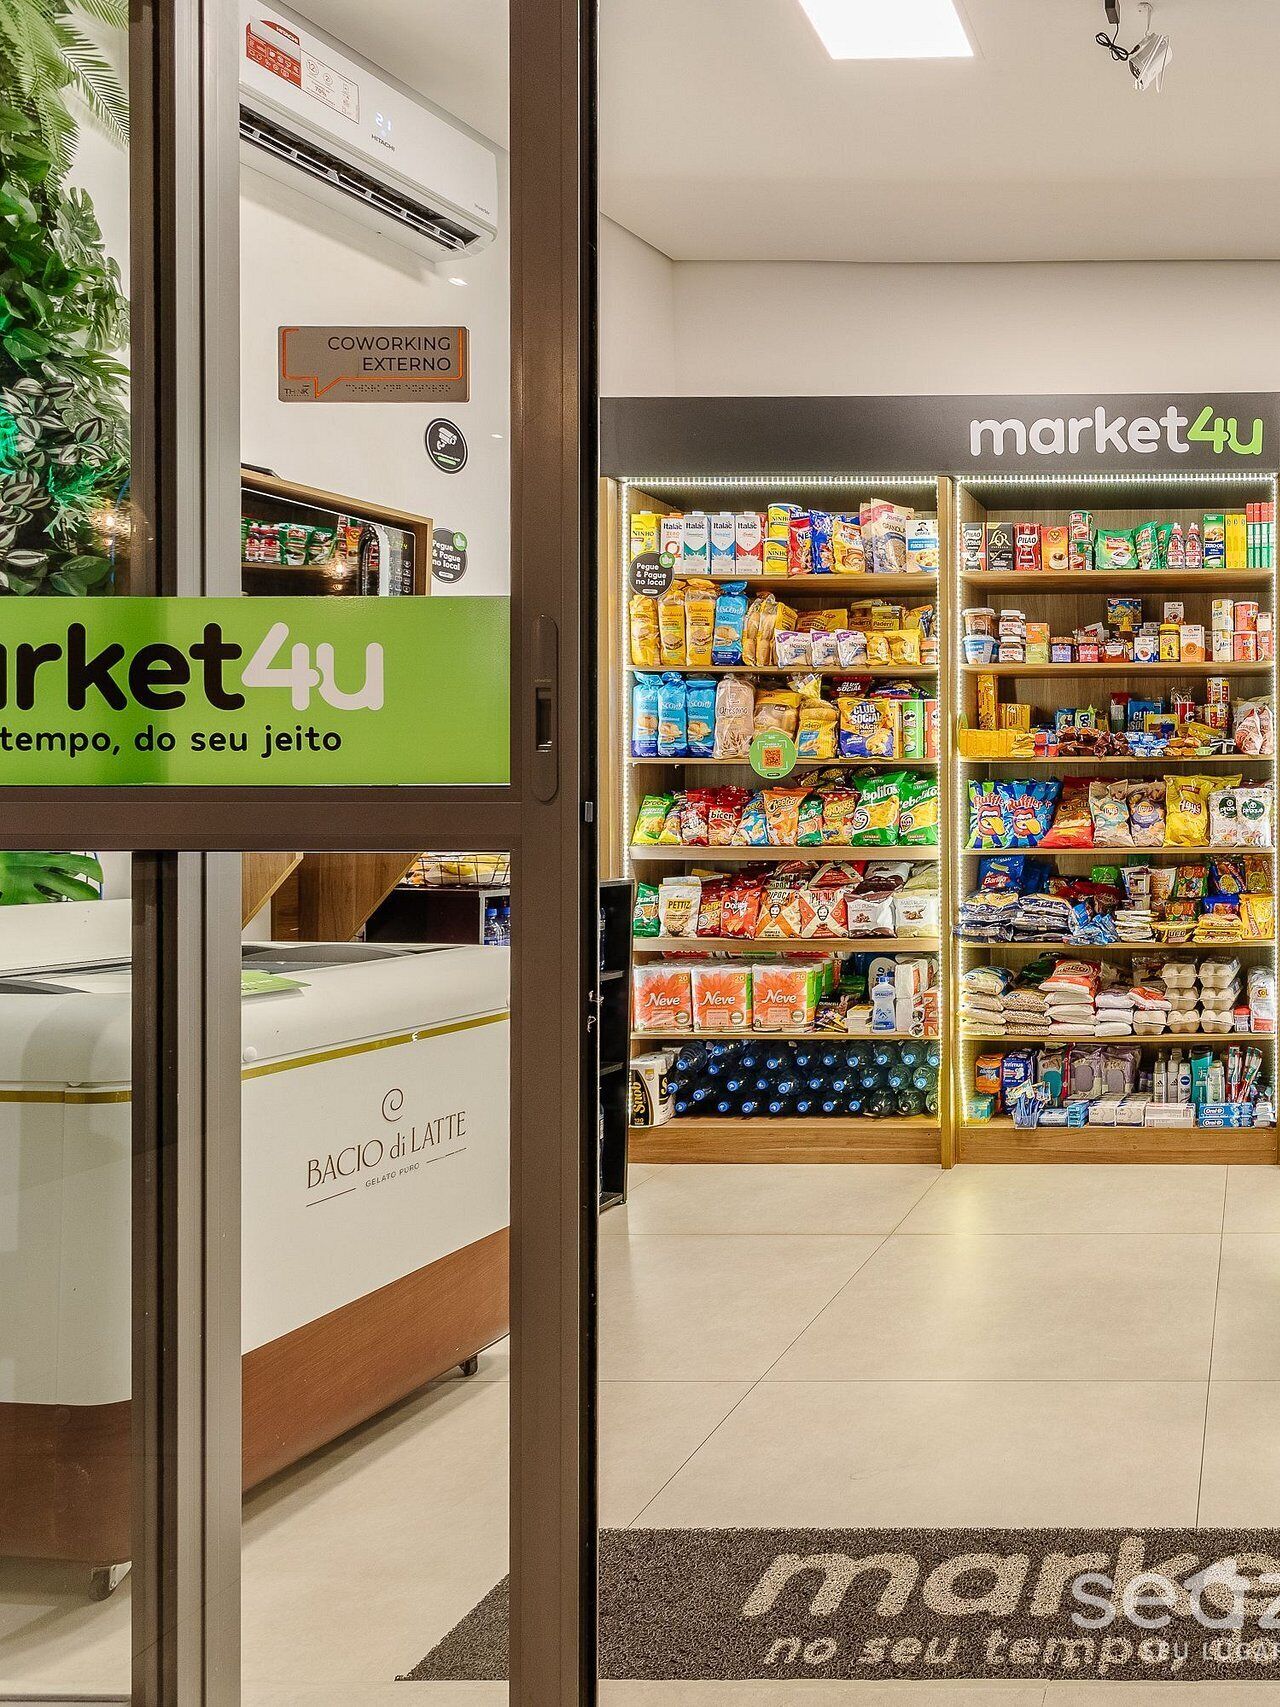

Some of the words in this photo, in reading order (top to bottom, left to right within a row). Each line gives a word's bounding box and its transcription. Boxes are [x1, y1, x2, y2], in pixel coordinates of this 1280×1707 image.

[371, 134, 396, 152] HITACHI
[327, 336, 451, 350] COWORKING
[363, 357, 451, 371] EXTERNO
[970, 406, 1263, 456] market4u
[440, 551, 461, 562] Pague
[443, 561, 460, 570] local
[636, 563, 659, 571] Pegue
[644, 571, 667, 579] Pague
[853, 704, 876, 714] CLUB
[851, 713, 881, 724] SOCIAL
[0, 725, 121, 758] tempo,
[135, 725, 176, 752] do
[191, 732, 248, 752] seu
[261, 725, 342, 758] jeito
[1007, 794, 1042, 812] Ruffles
[668, 901, 691, 909] PETTIZ
[645, 992, 681, 1007] Neve
[700, 991, 736, 1005] Neve
[761, 989, 797, 1003] Neve
[633, 1081, 645, 1113] Snob
[306, 1139, 384, 1189] BACIO
[389, 1132, 405, 1159] di
[411, 1111, 467, 1154] LATTE
[365, 1170, 397, 1187] GELATO
[399, 1162, 420, 1176] PURO
[763, 1636, 838, 1665] no
[858, 1636, 958, 1665] seu
